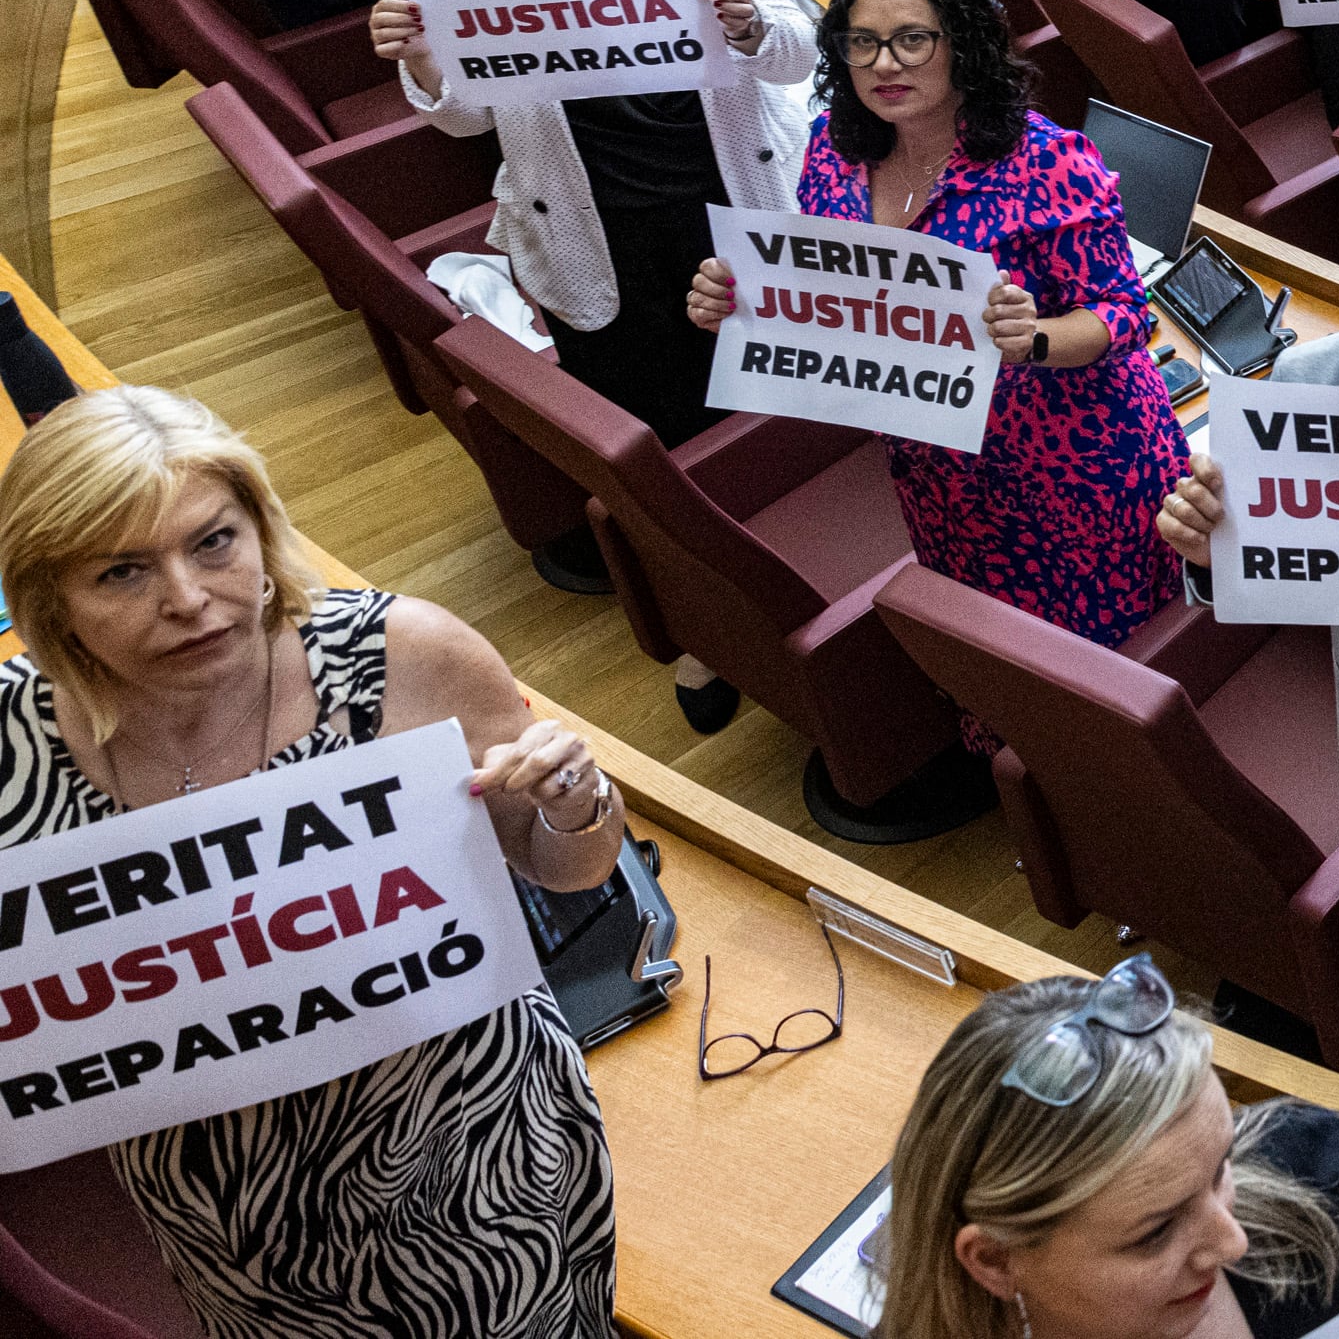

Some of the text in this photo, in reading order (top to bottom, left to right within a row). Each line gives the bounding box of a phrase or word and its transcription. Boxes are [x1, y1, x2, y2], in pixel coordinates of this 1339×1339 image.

[459, 29, 705, 80] REPARACIÓ
[746, 232, 967, 291] VERITAT
[755, 285, 976, 351] JUSTÍCIA
[740, 341, 975, 409] REPARACIÓ
[0, 920, 485, 1120] REPARACIÓ
